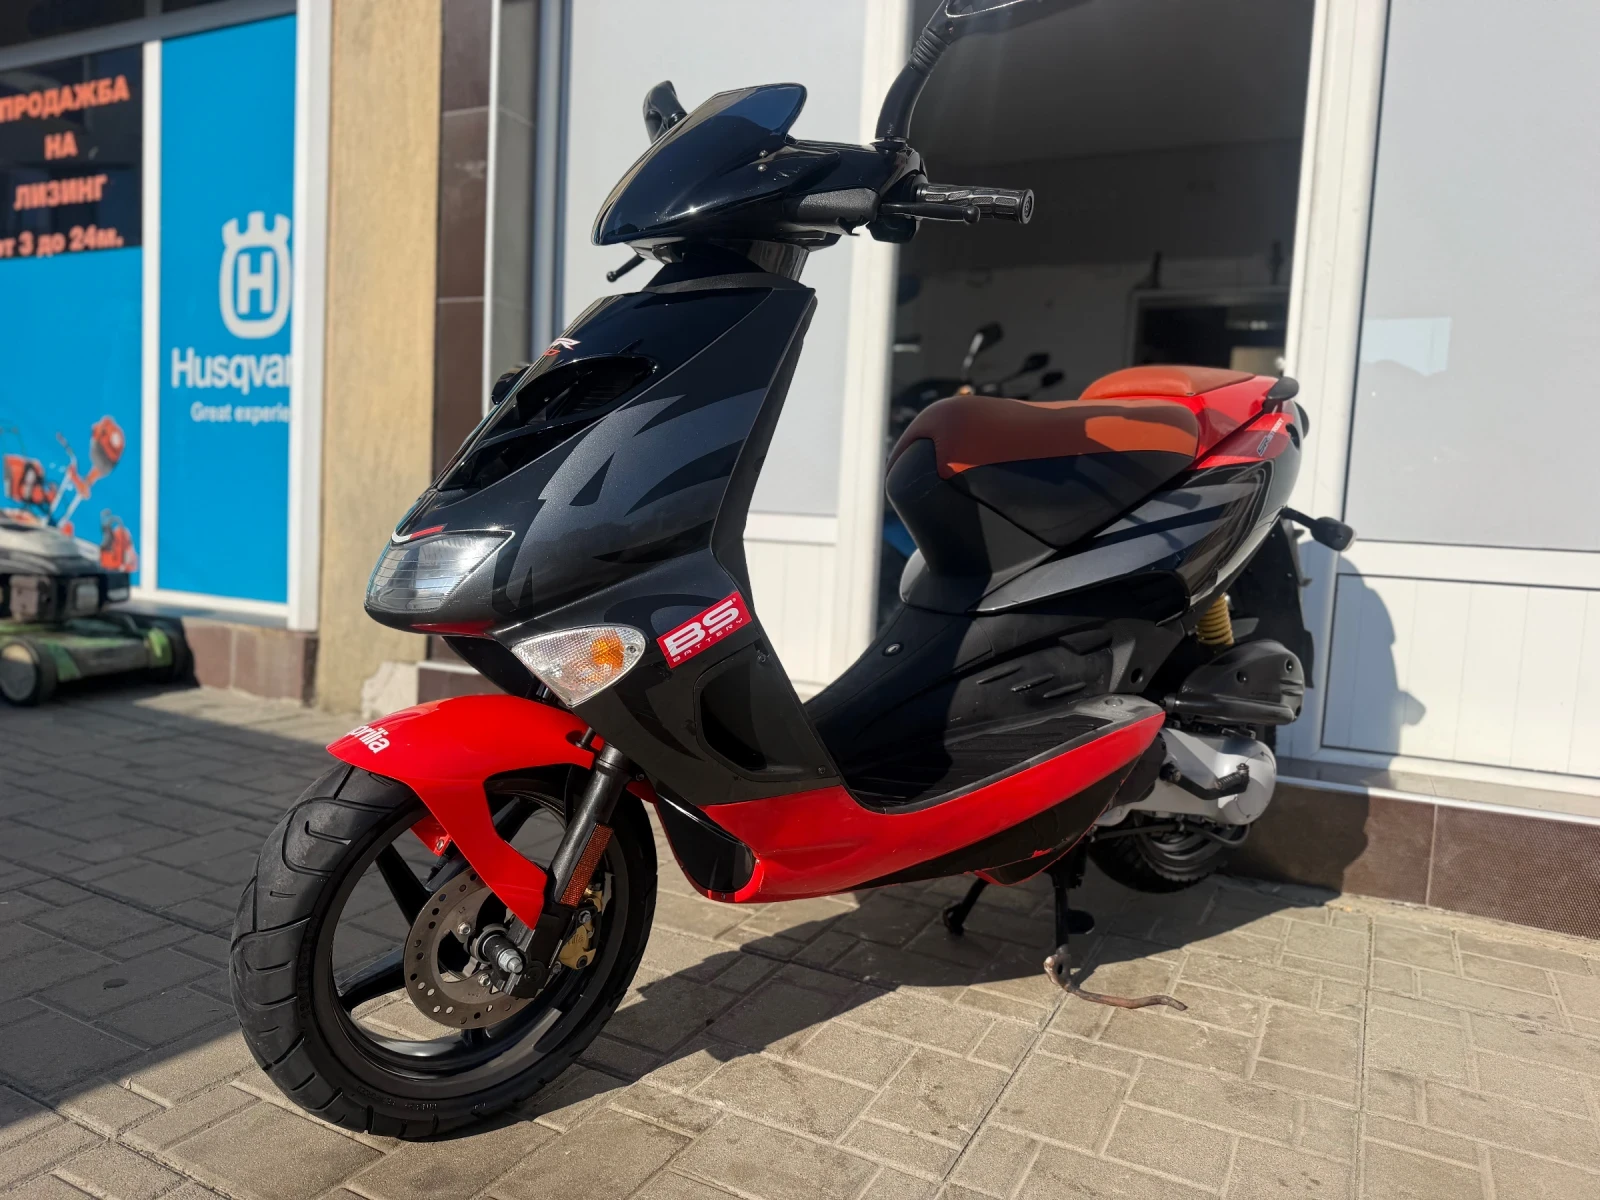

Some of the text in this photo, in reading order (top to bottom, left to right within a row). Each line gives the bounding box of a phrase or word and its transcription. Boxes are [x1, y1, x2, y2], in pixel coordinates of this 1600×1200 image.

[44, 131, 78, 160] НА
[13, 174, 108, 210] ЛИЗИНГ
[18, 231, 34, 257] 3
[36, 232, 66, 258] до
[190, 401, 232, 423] Great
[664, 599, 739, 657] BS
[673, 618, 743, 663] BATTERY
